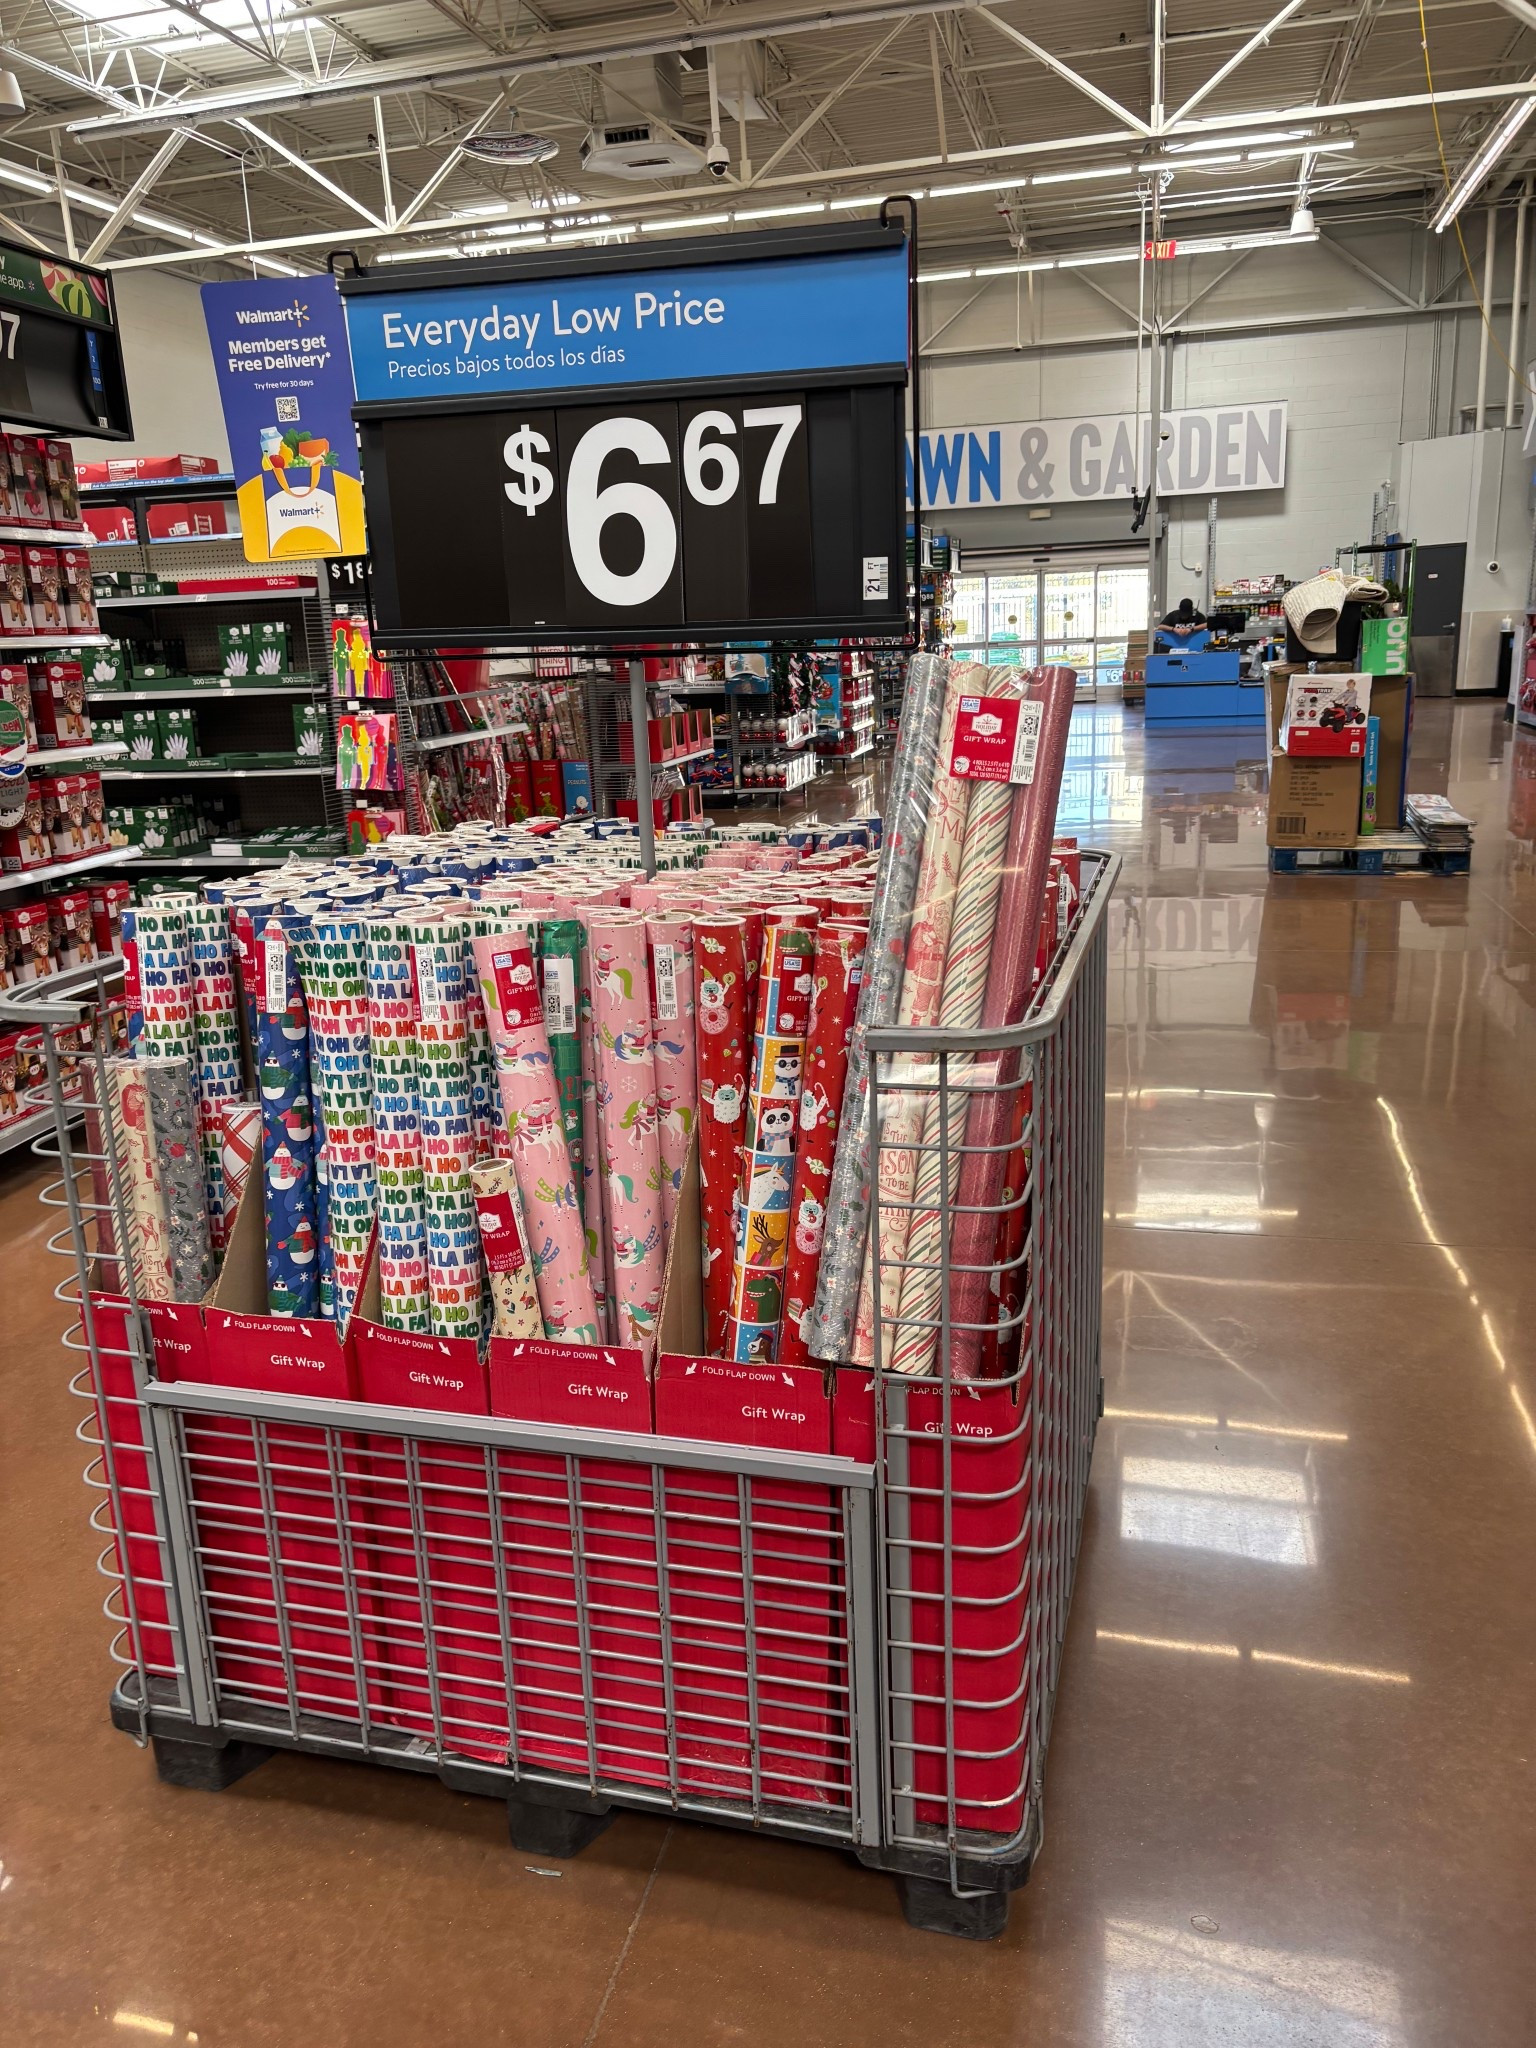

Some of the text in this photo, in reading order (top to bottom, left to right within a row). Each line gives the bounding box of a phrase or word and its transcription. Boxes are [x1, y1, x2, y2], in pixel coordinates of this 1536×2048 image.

[382, 290, 726, 354] Everyday Low Price
[228, 335, 326, 354] Members get
[228, 358, 262, 372] Free
[388, 344, 626, 380] Precios bajos todos los días
[1017, 426, 1055, 500] &
[1070, 409, 1283, 497] GARDEN
[868, 562, 874, 570] FT
[267, 578, 278, 586] 100
[867, 579, 880, 592] 21
[1386, 620, 1408, 675] UNO
[983, 737, 1006, 745] WRAP
[138, 917, 158, 932] HO
[209, 926, 227, 941] LA
[370, 926, 392, 941] HO
[146, 935, 167, 950] LA
[172, 969, 188, 985] FA
[369, 964, 384, 980] LA
[213, 978, 232, 993] HO
[164, 1006, 187, 1021] HO
[384, 1002, 408, 1018] HO
[216, 1012, 233, 1027] FA
[165, 1041, 184, 1057] FA
[380, 1040, 400, 1056] LA
[427, 1044, 451, 1060] HO
[218, 1063, 237, 1079] LA
[404, 1076, 420, 1093] FA
[432, 1101, 454, 1117] LA
[393, 1114, 416, 1130] HO
[394, 1152, 414, 1168] FA
[437, 1157, 461, 1173] HO
[402, 1169, 423, 1186] HO
[886, 1178, 909, 1190] TO BE
[436, 1195, 456, 1211] FA
[385, 1226, 402, 1241] FA
[490, 1231, 510, 1239] WRAP
[399, 1261, 422, 1277] HO
[430, 1269, 445, 1285] FA
[411, 1277, 428, 1295] HO
[147, 1307, 163, 1316] OWN
[234, 1320, 296, 1333] FOLD FLAP DOWN
[163, 1339, 191, 1354] Wrap
[376, 1332, 434, 1349] FOLD FLAP DOWN
[530, 1346, 598, 1360] FOLD FLAP DOWN
[270, 1354, 325, 1372] Gift Wrap
[409, 1371, 464, 1390] Gift Wrap
[702, 1366, 776, 1382] FOLD FLAP DOWN
[568, 1383, 628, 1400] Gift Wrap
[742, 1406, 806, 1423] Gift Wrap
[956, 1423, 992, 1437] Wrap
